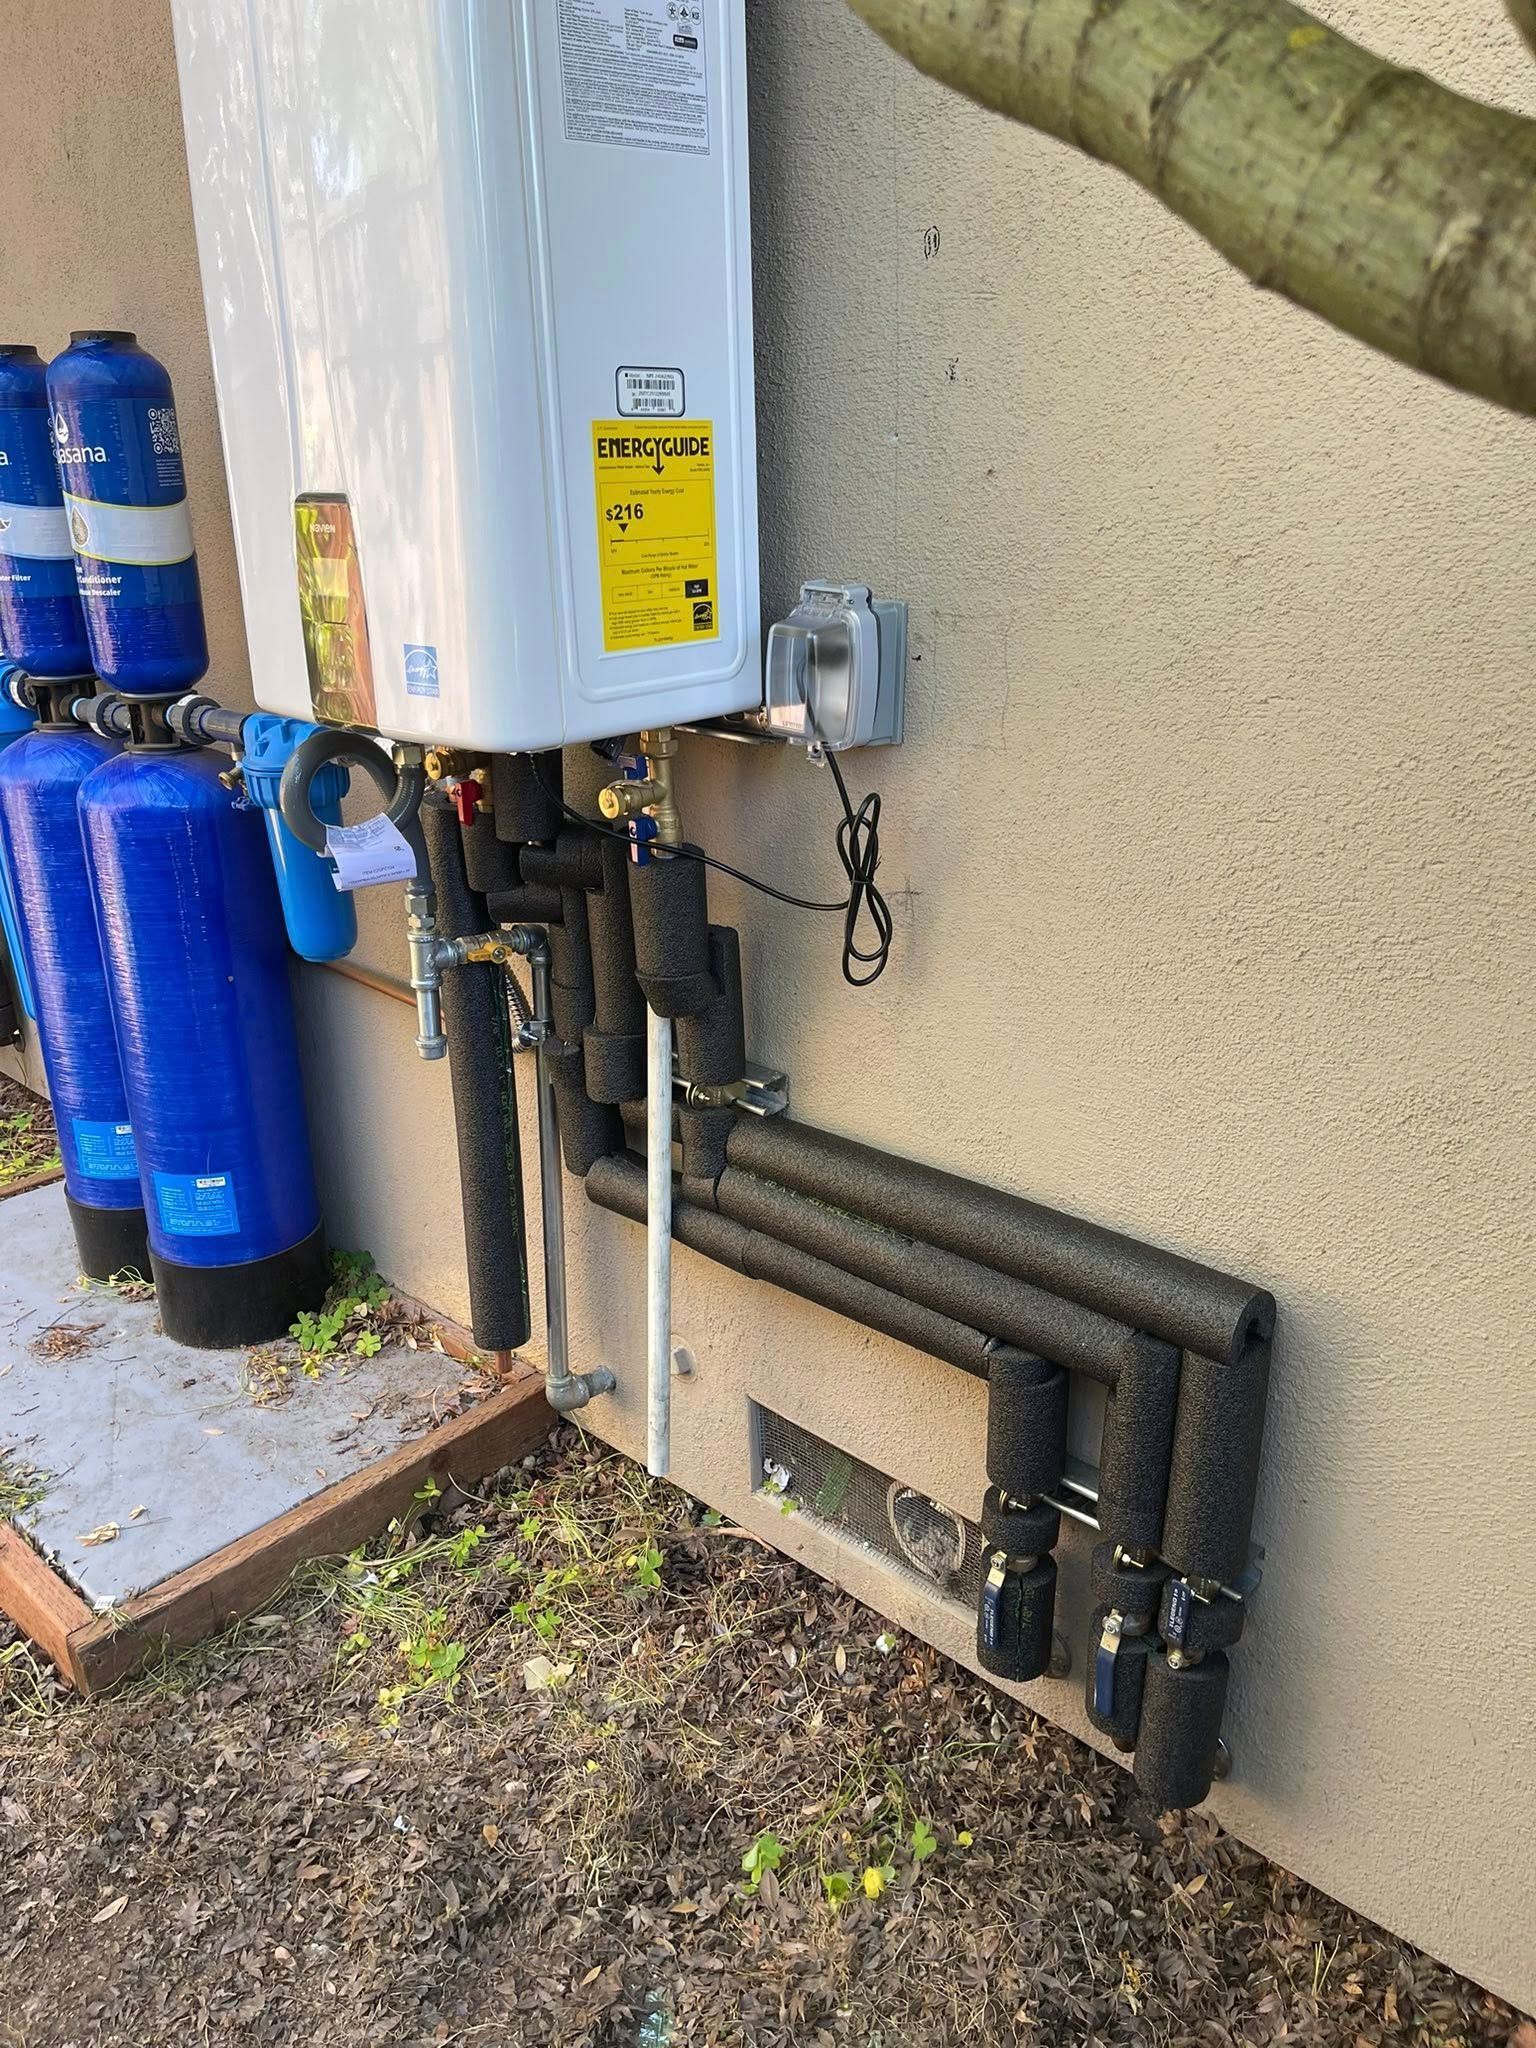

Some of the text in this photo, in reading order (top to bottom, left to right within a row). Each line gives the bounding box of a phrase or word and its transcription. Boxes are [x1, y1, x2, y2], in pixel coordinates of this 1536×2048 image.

[598, 437, 710, 458] ENERGYGUIDE
[606, 503, 644, 521] $216
[92, 588, 121, 596] Descaler
